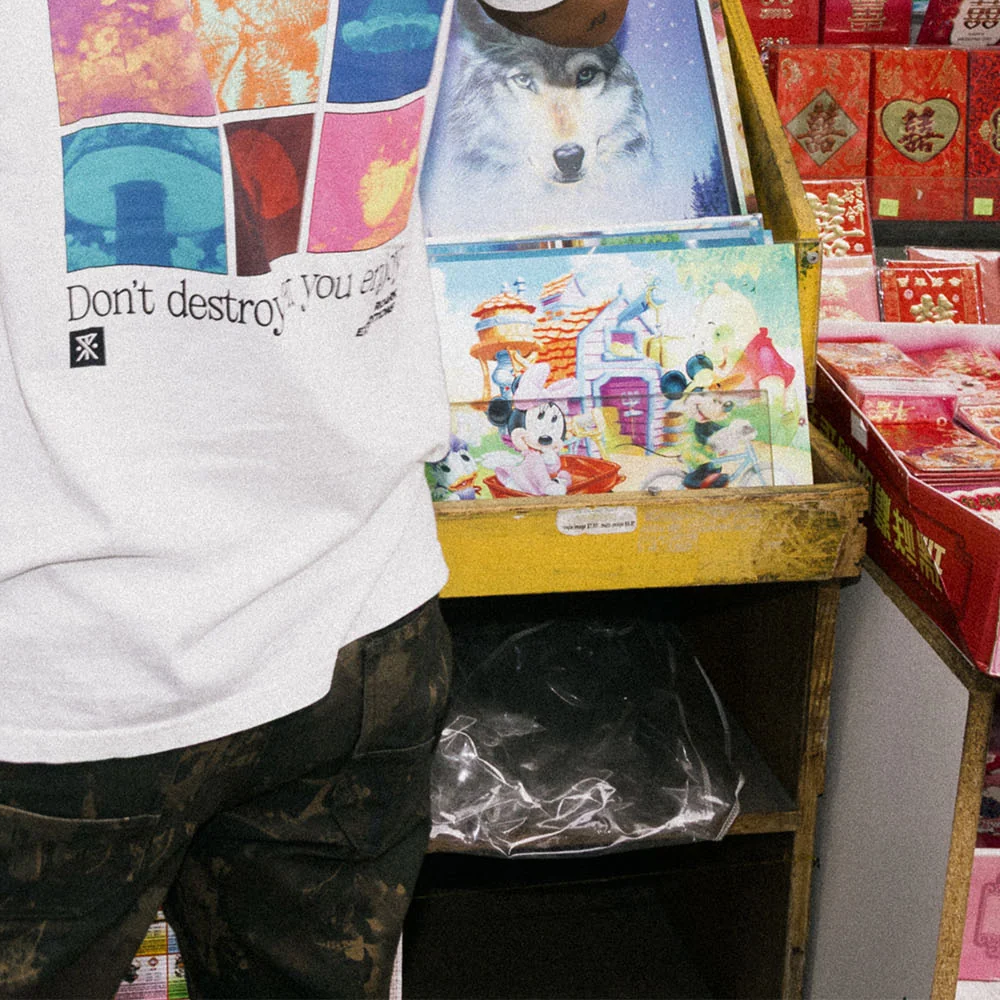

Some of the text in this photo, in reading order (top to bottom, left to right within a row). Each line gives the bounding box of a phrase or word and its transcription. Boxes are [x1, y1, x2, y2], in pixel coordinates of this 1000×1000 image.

[66, 279, 156, 322] Don't
[167, 280, 286, 337] destroy
[300, 272, 353, 313] you
